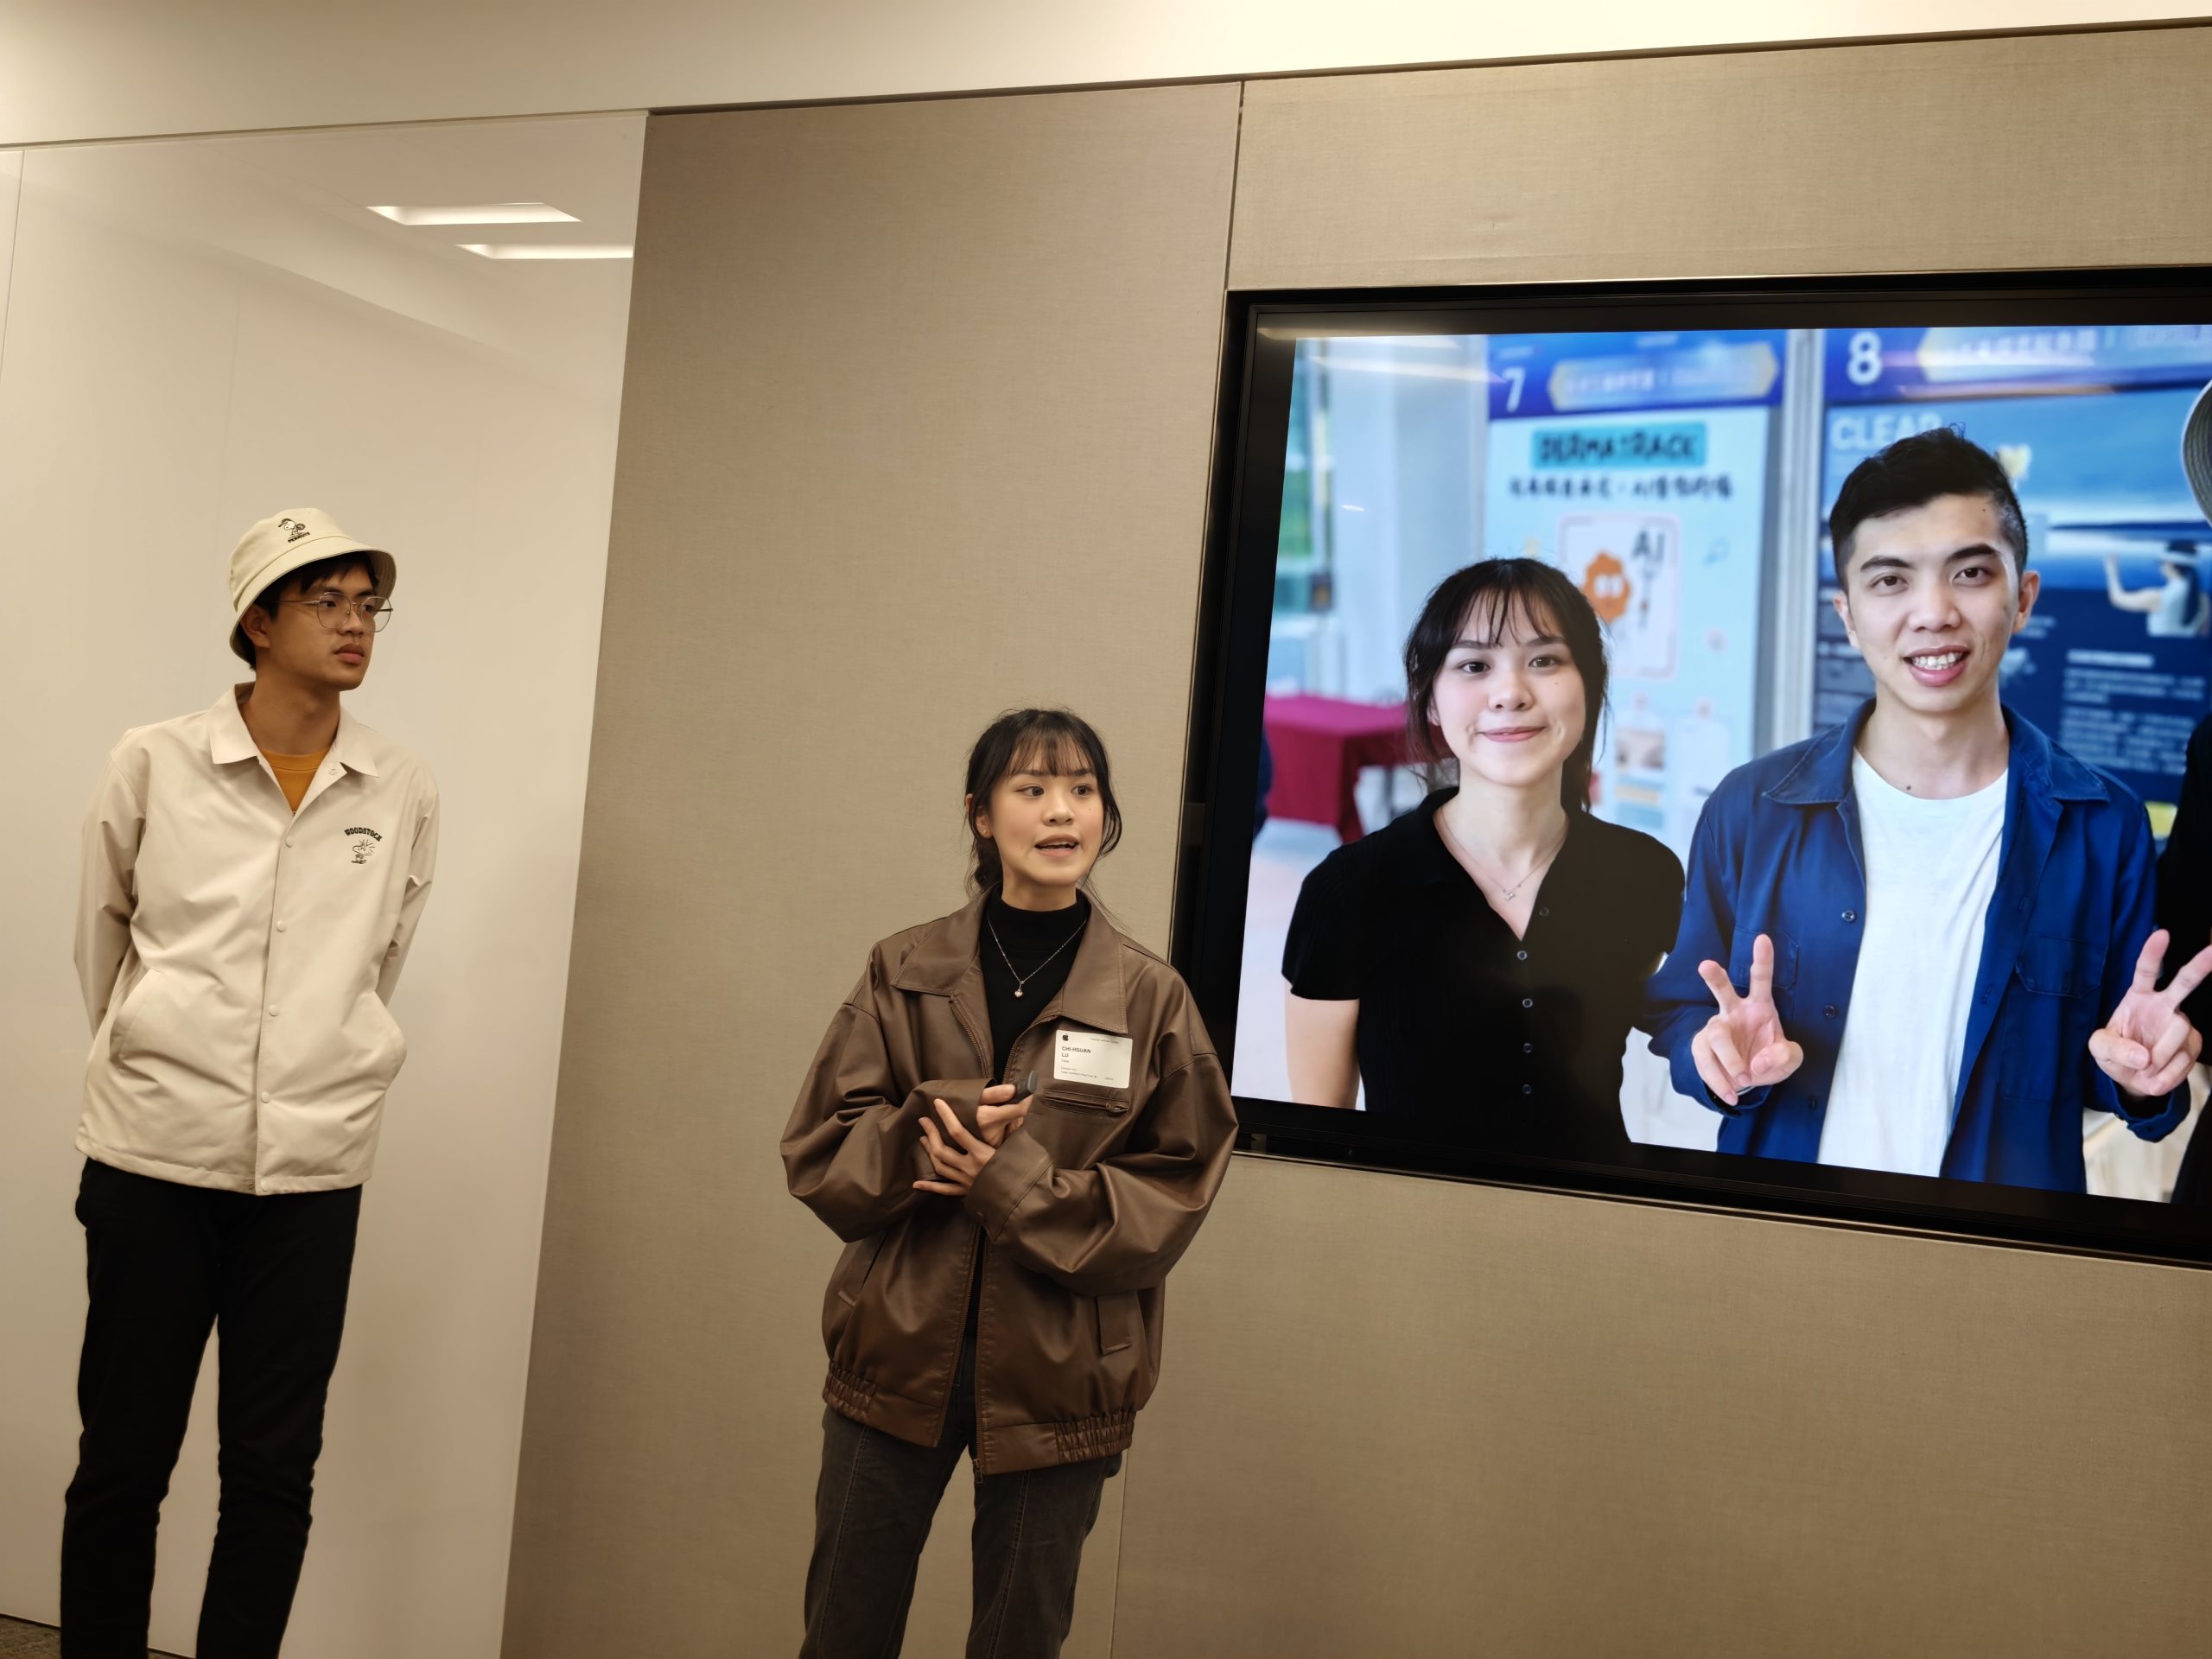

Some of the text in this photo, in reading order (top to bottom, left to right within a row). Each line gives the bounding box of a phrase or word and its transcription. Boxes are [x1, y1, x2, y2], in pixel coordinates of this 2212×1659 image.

[1848, 332, 1883, 385] 8
[1503, 366, 1525, 413] 7
[344, 827, 383, 842] WOODSTOCK
